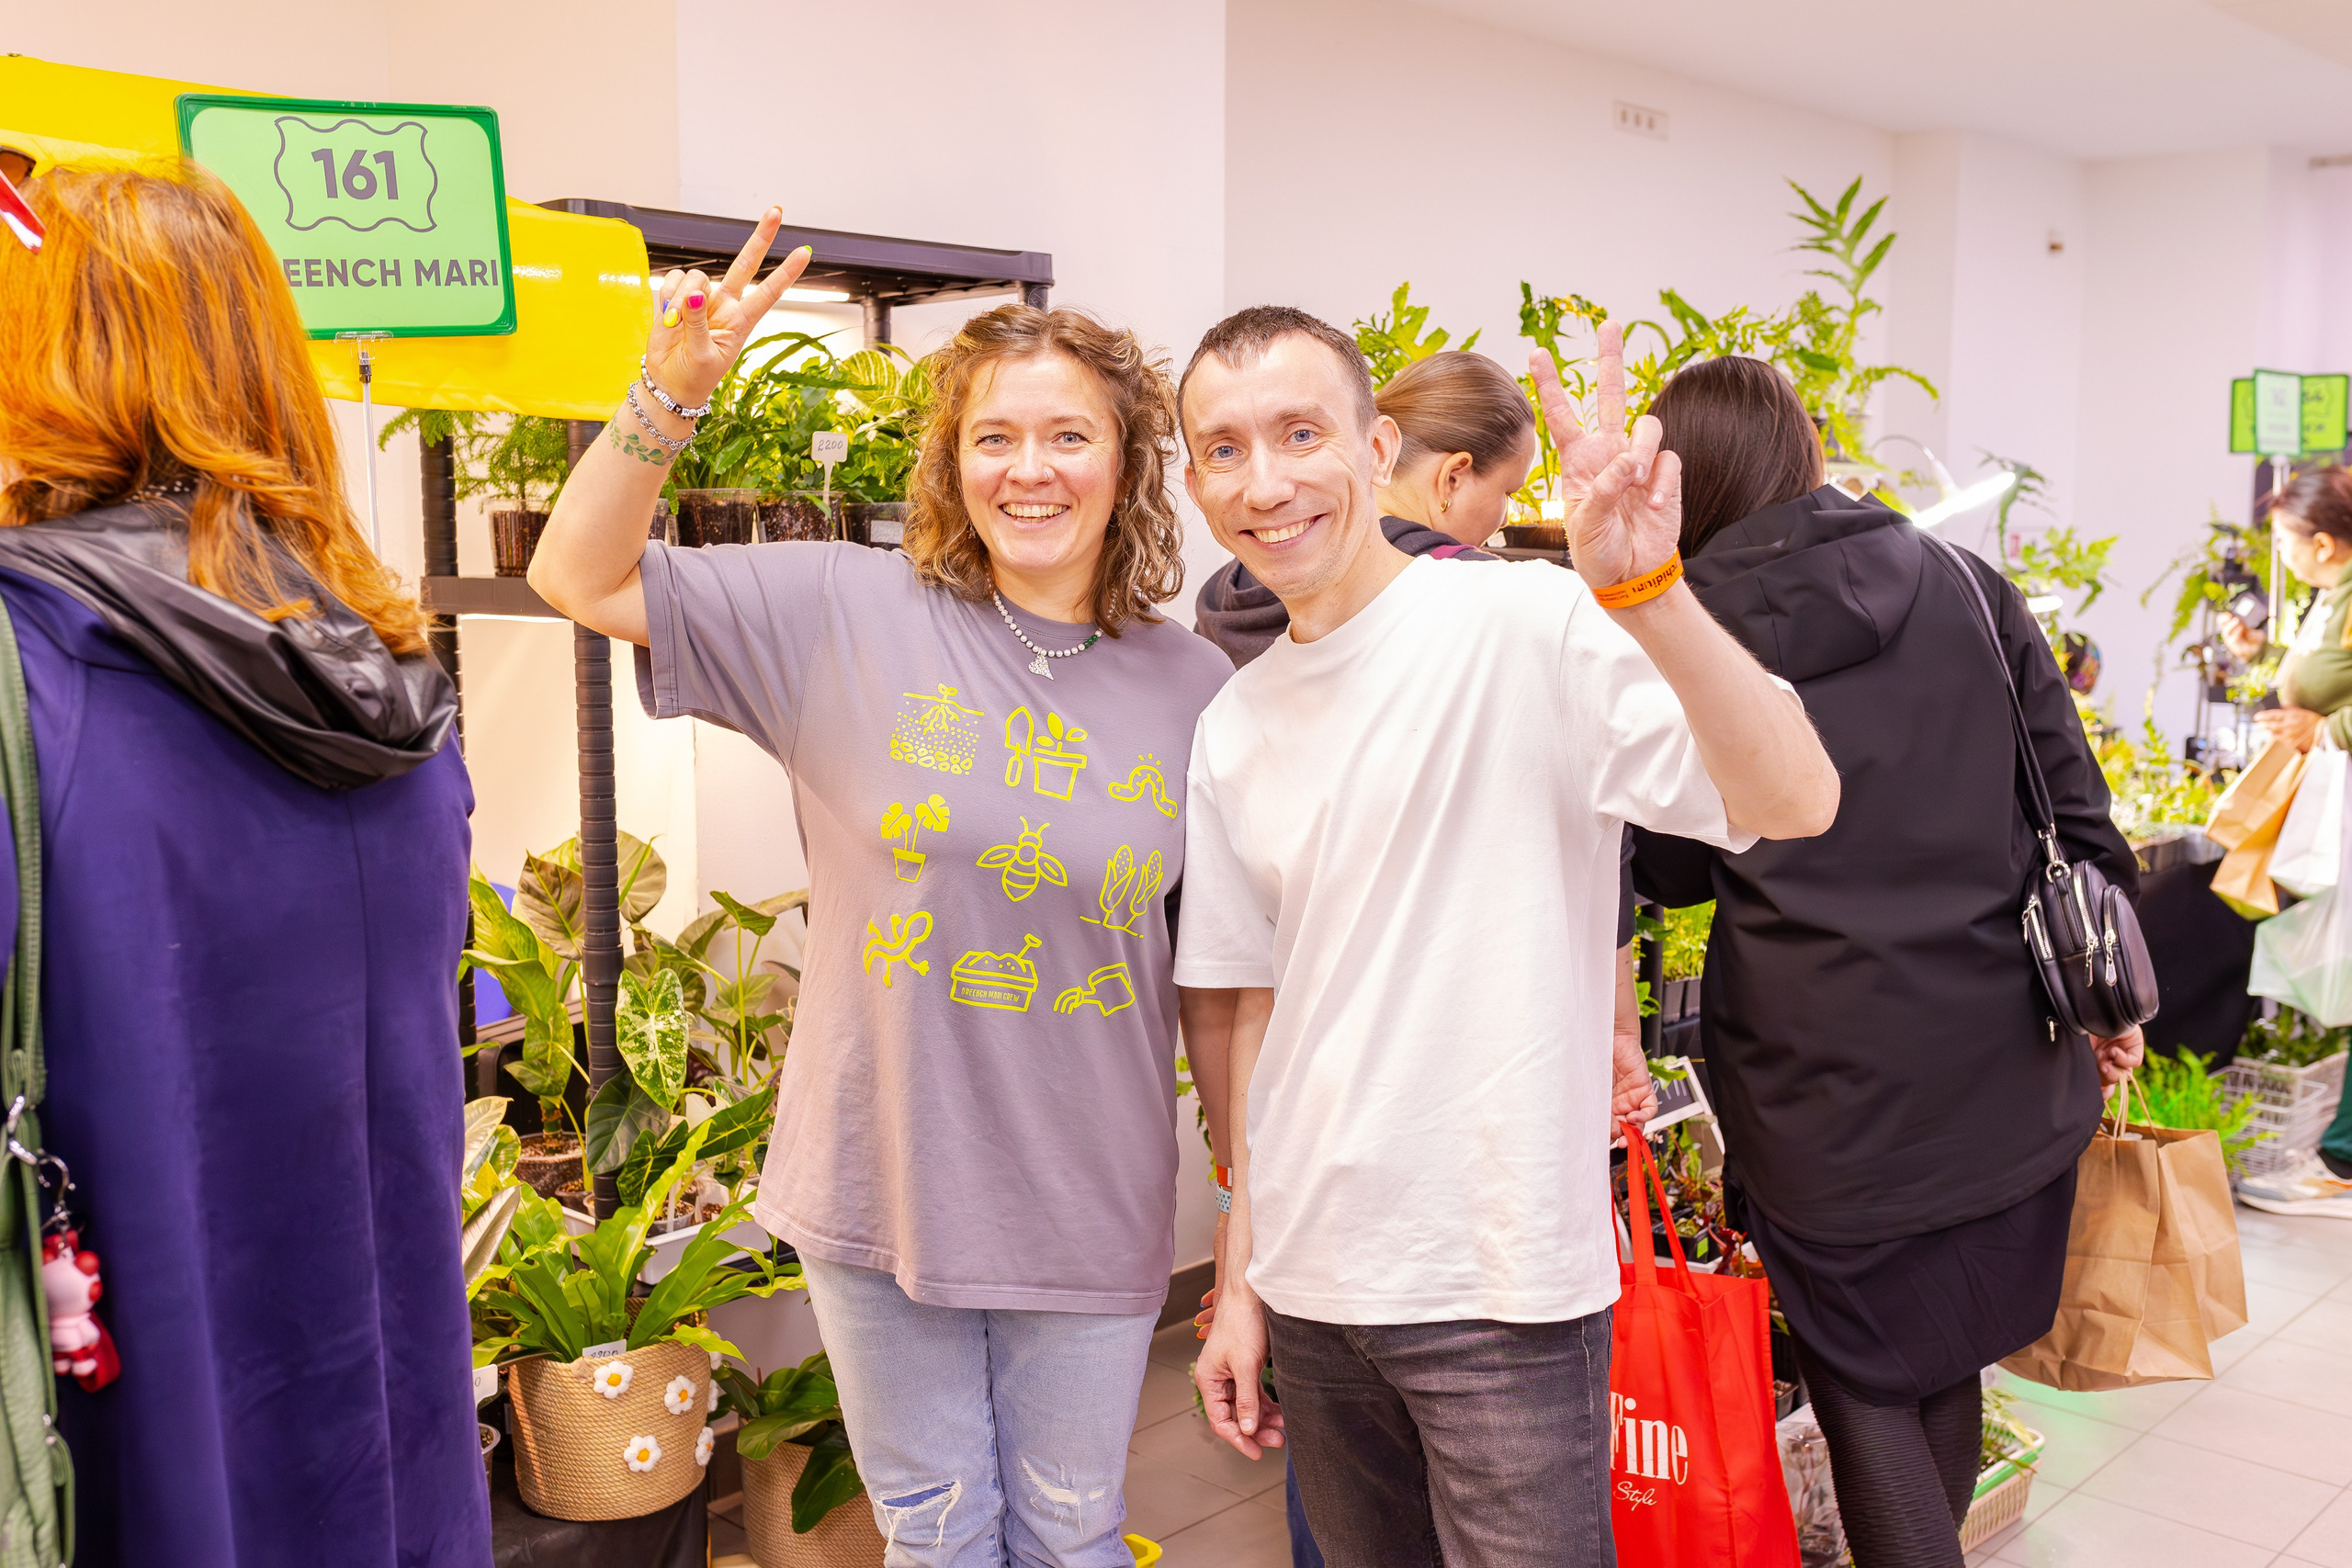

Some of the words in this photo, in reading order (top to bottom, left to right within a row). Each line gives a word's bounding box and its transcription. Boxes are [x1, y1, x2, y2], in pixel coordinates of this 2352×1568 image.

[311, 148, 399, 200] 161
[283, 258, 401, 288] EENCH
[415, 258, 499, 287] MARI
[818, 439, 843, 452] 2200
[1631, 560, 1679, 593] rchidium
[1612, 1481, 1657, 1511] Style
